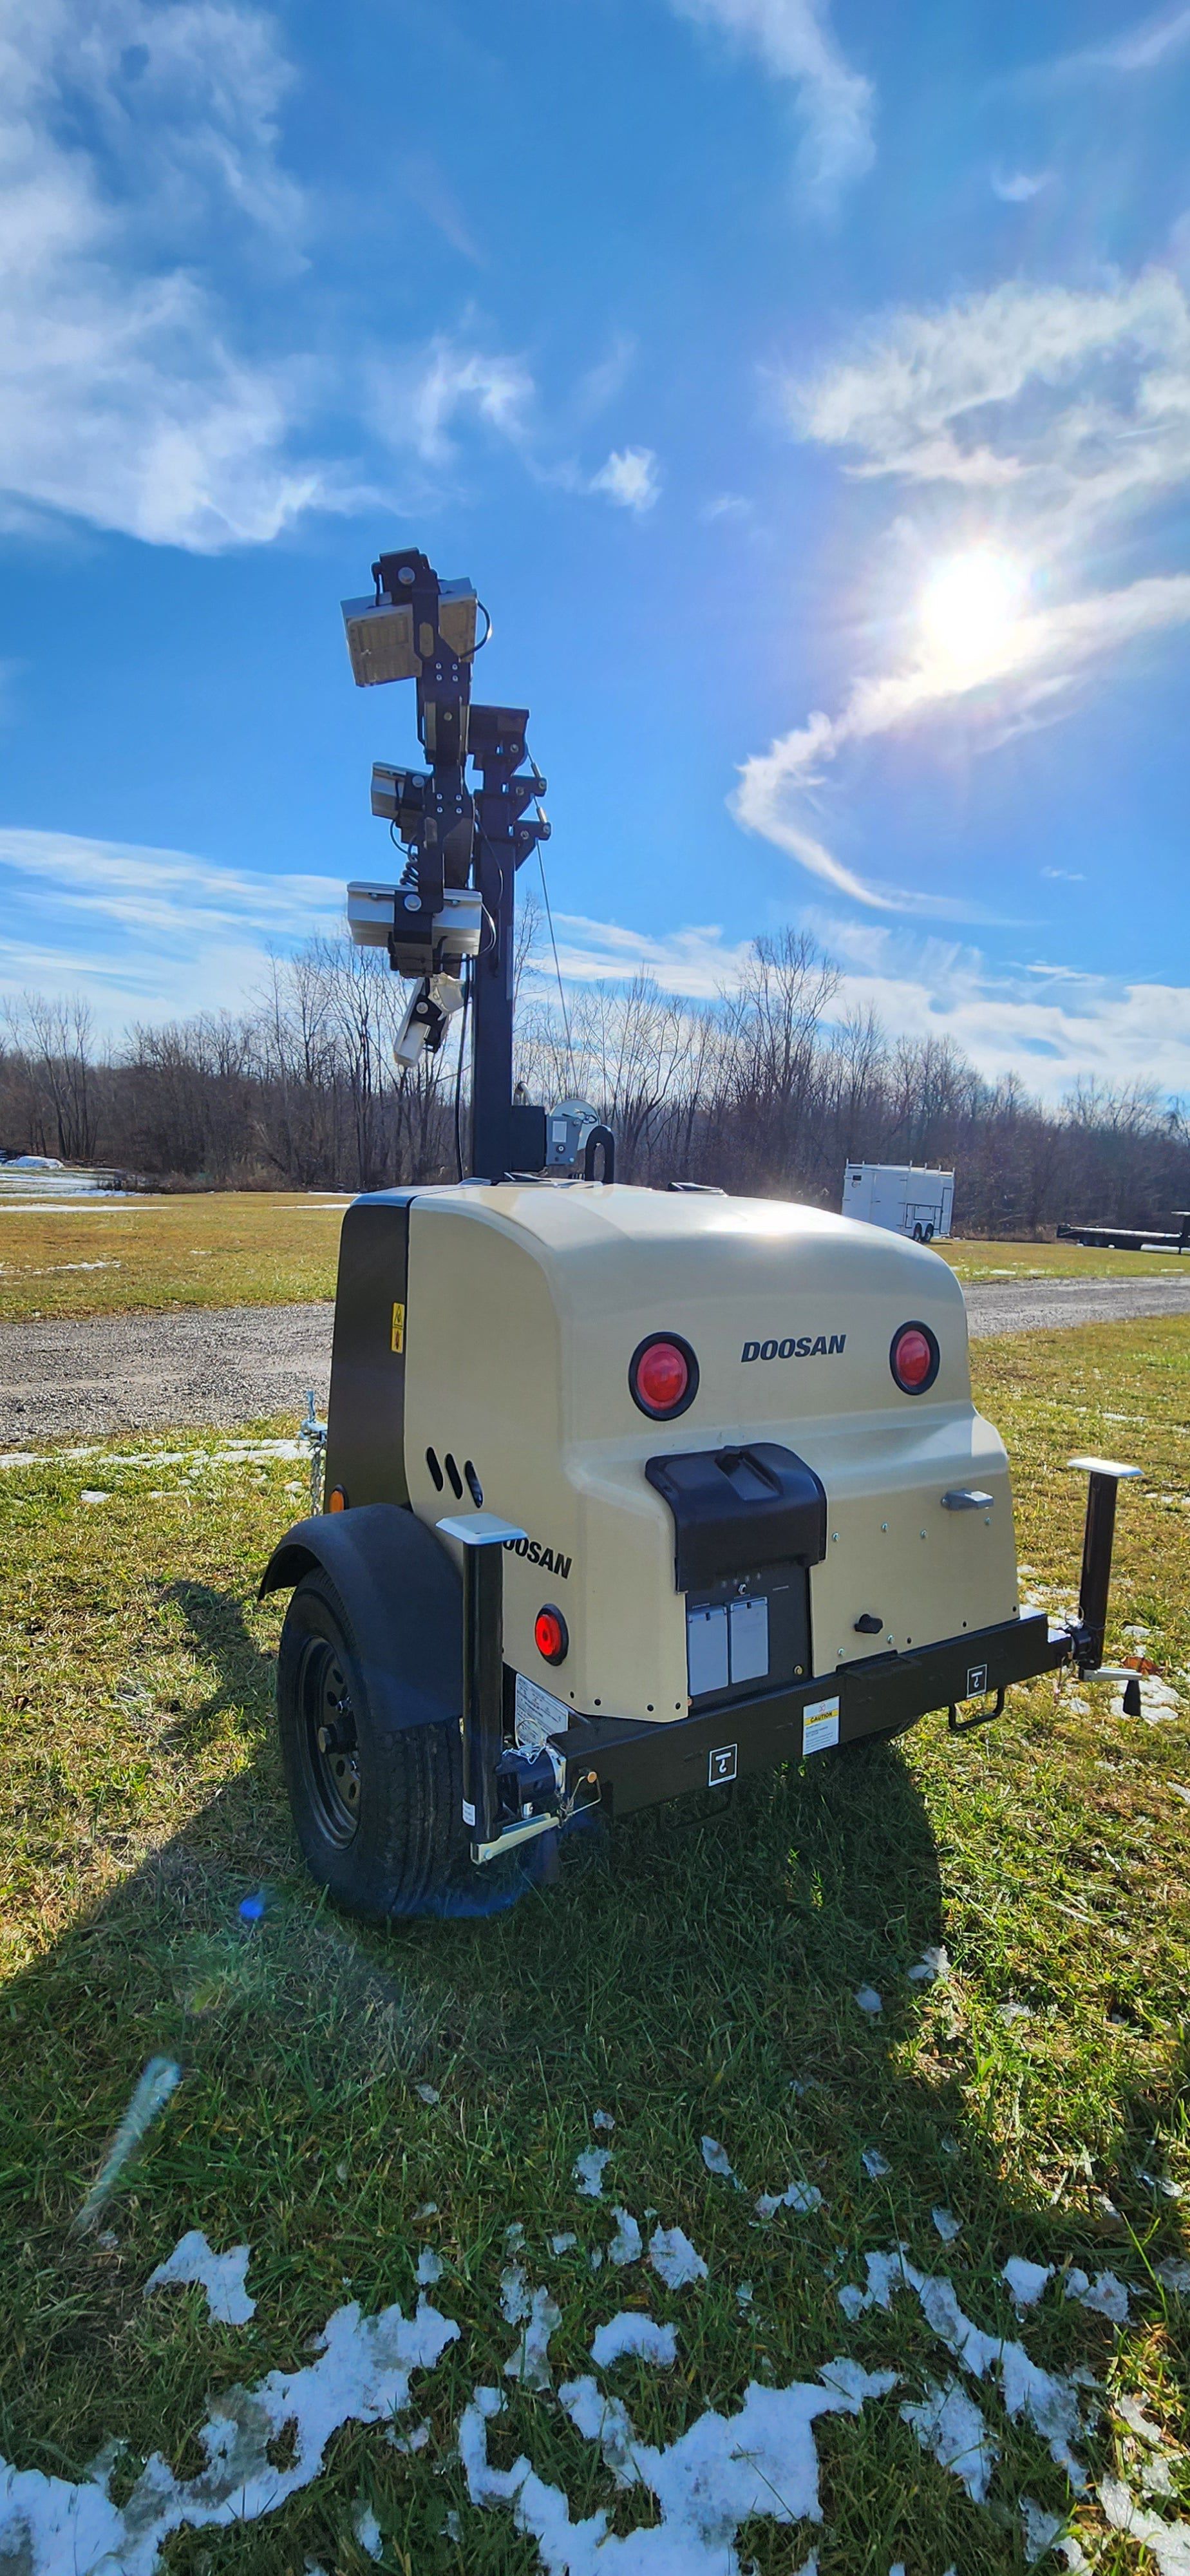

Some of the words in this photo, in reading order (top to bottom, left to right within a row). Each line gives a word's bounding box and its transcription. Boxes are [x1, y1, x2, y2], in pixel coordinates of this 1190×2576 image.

[741, 1334, 846, 1362] DOOSAN
[502, 1537, 572, 1579] OOSAN
[810, 1711, 833, 1723] CAUTION
